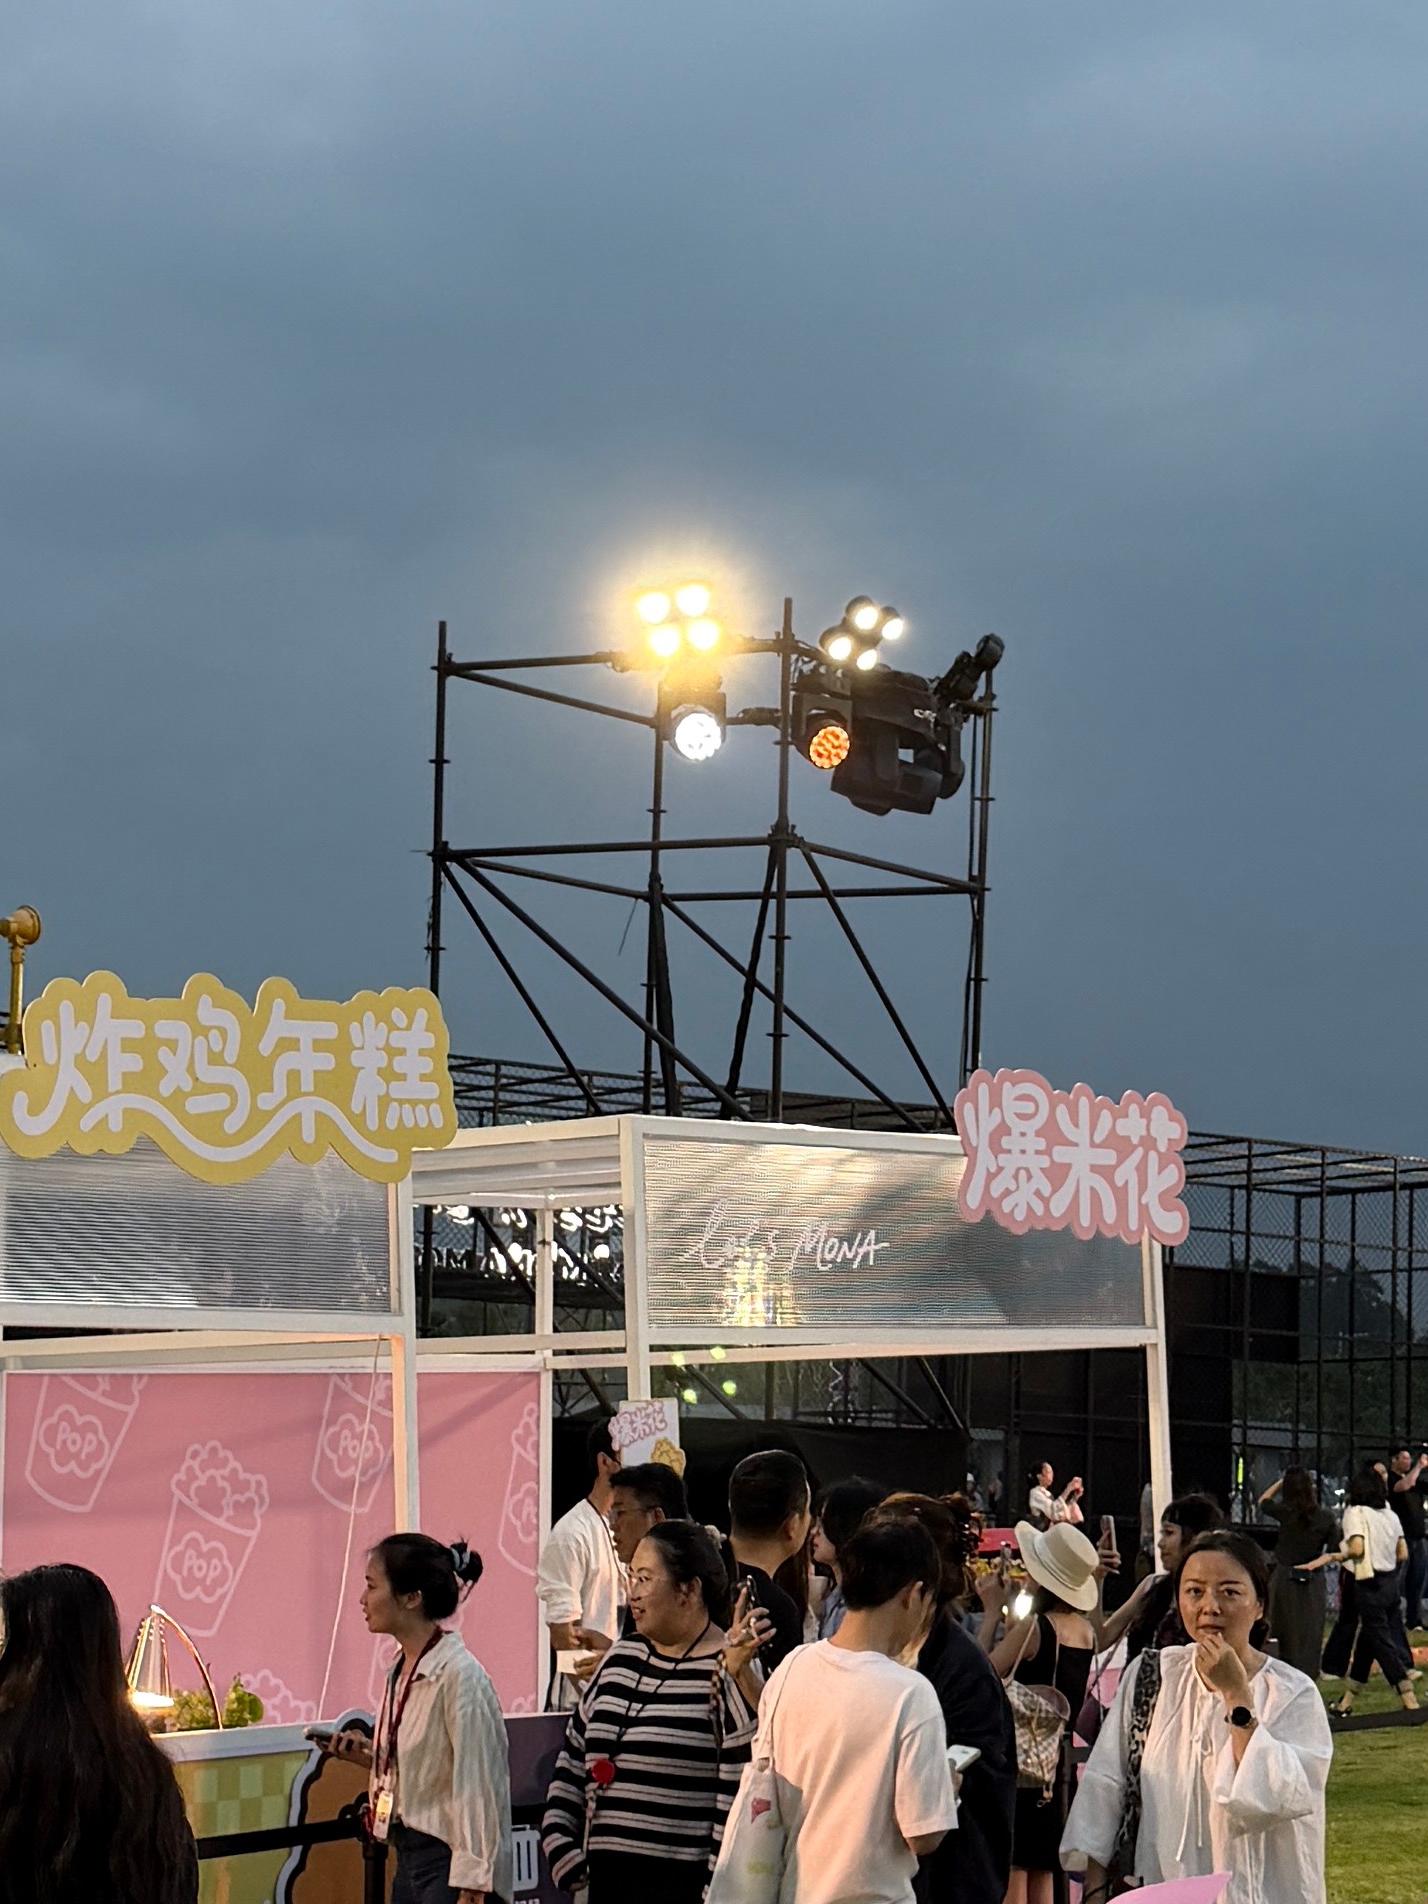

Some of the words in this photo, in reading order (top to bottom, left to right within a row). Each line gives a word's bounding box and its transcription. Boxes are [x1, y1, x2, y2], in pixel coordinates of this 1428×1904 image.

[12, 993, 441, 1163] 炸鸡年糕
[963, 1081, 1183, 1234] 爆米花
